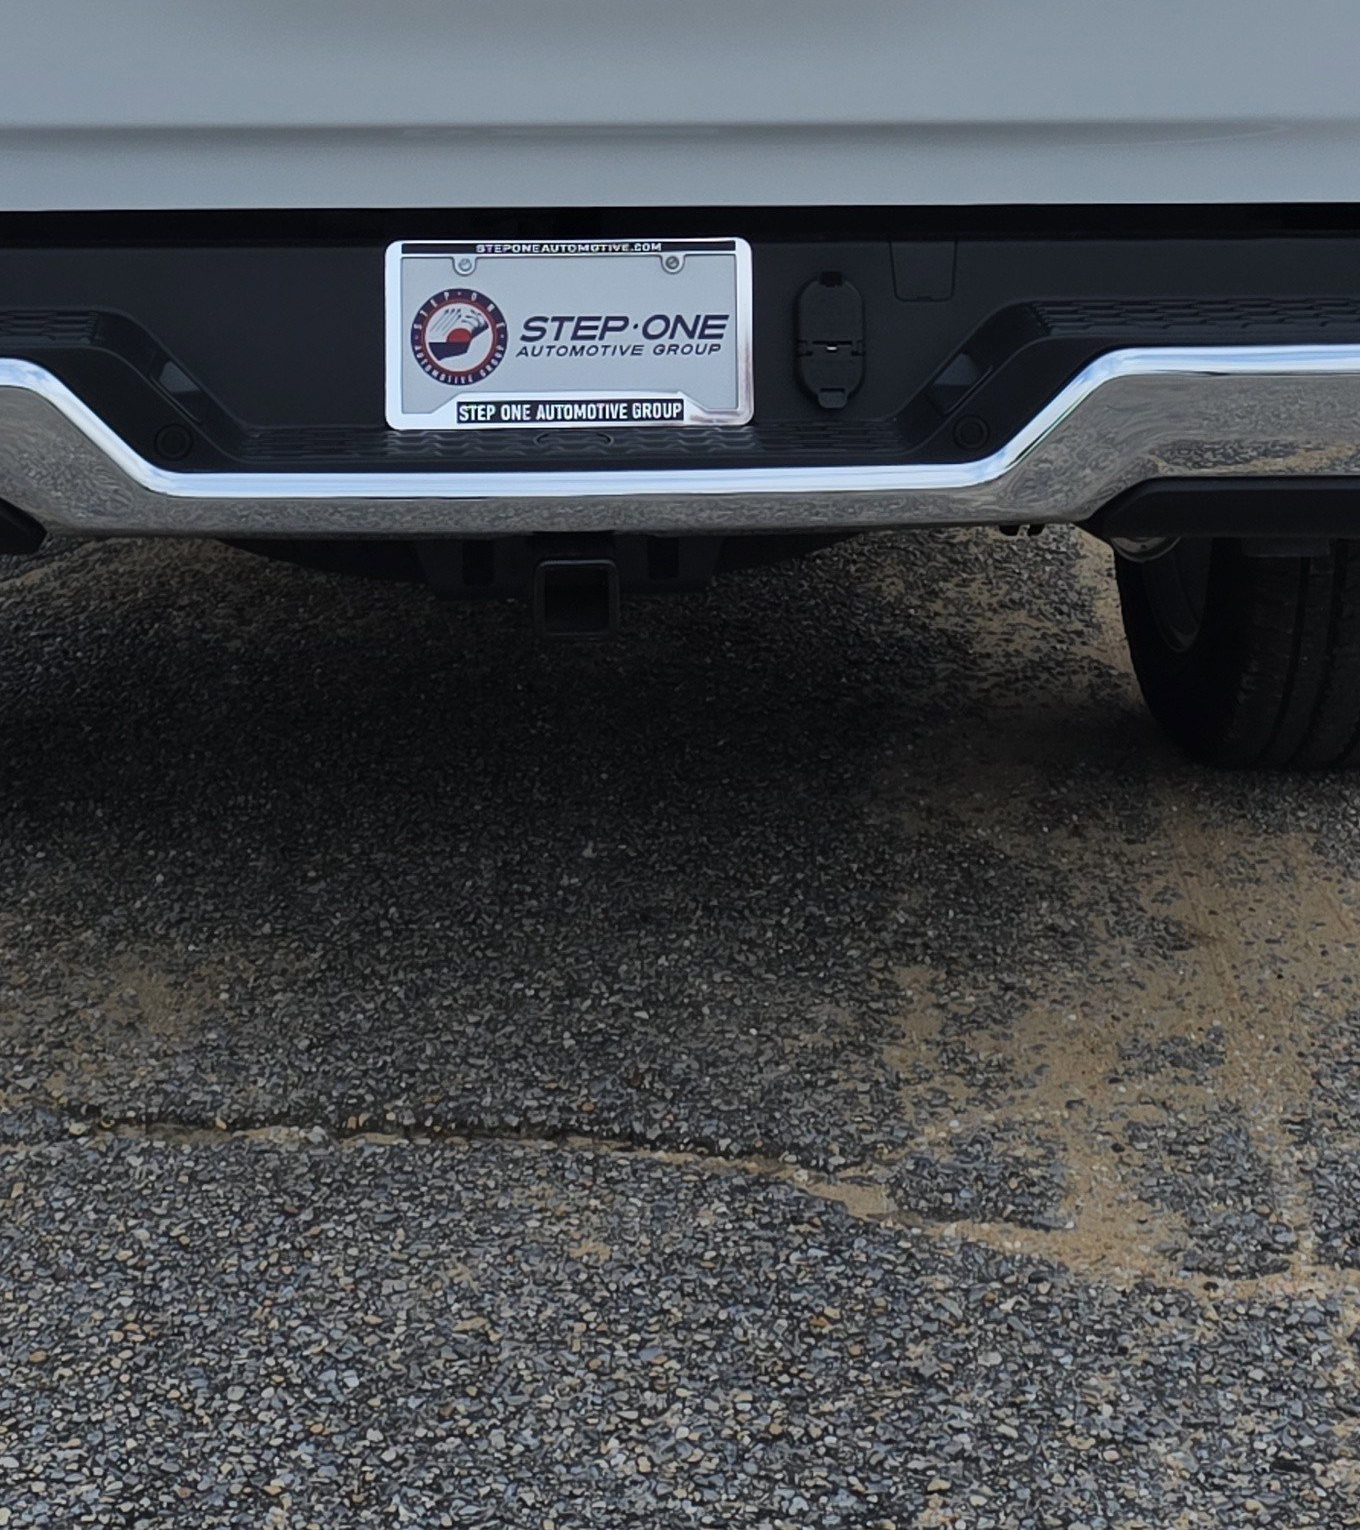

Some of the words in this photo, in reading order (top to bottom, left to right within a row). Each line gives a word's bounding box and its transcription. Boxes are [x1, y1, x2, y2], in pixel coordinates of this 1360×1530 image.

[475, 243, 662, 254] STEPONEAUTOMOTIVE.COM
[515, 344, 645, 358] AUTOMOTIVE
[652, 343, 722, 357] GROUP
[458, 404, 496, 422] STEP
[500, 404, 532, 421] ONE
[535, 402, 628, 421] AUTOMOTIVE
[632, 401, 683, 420] GROUP
